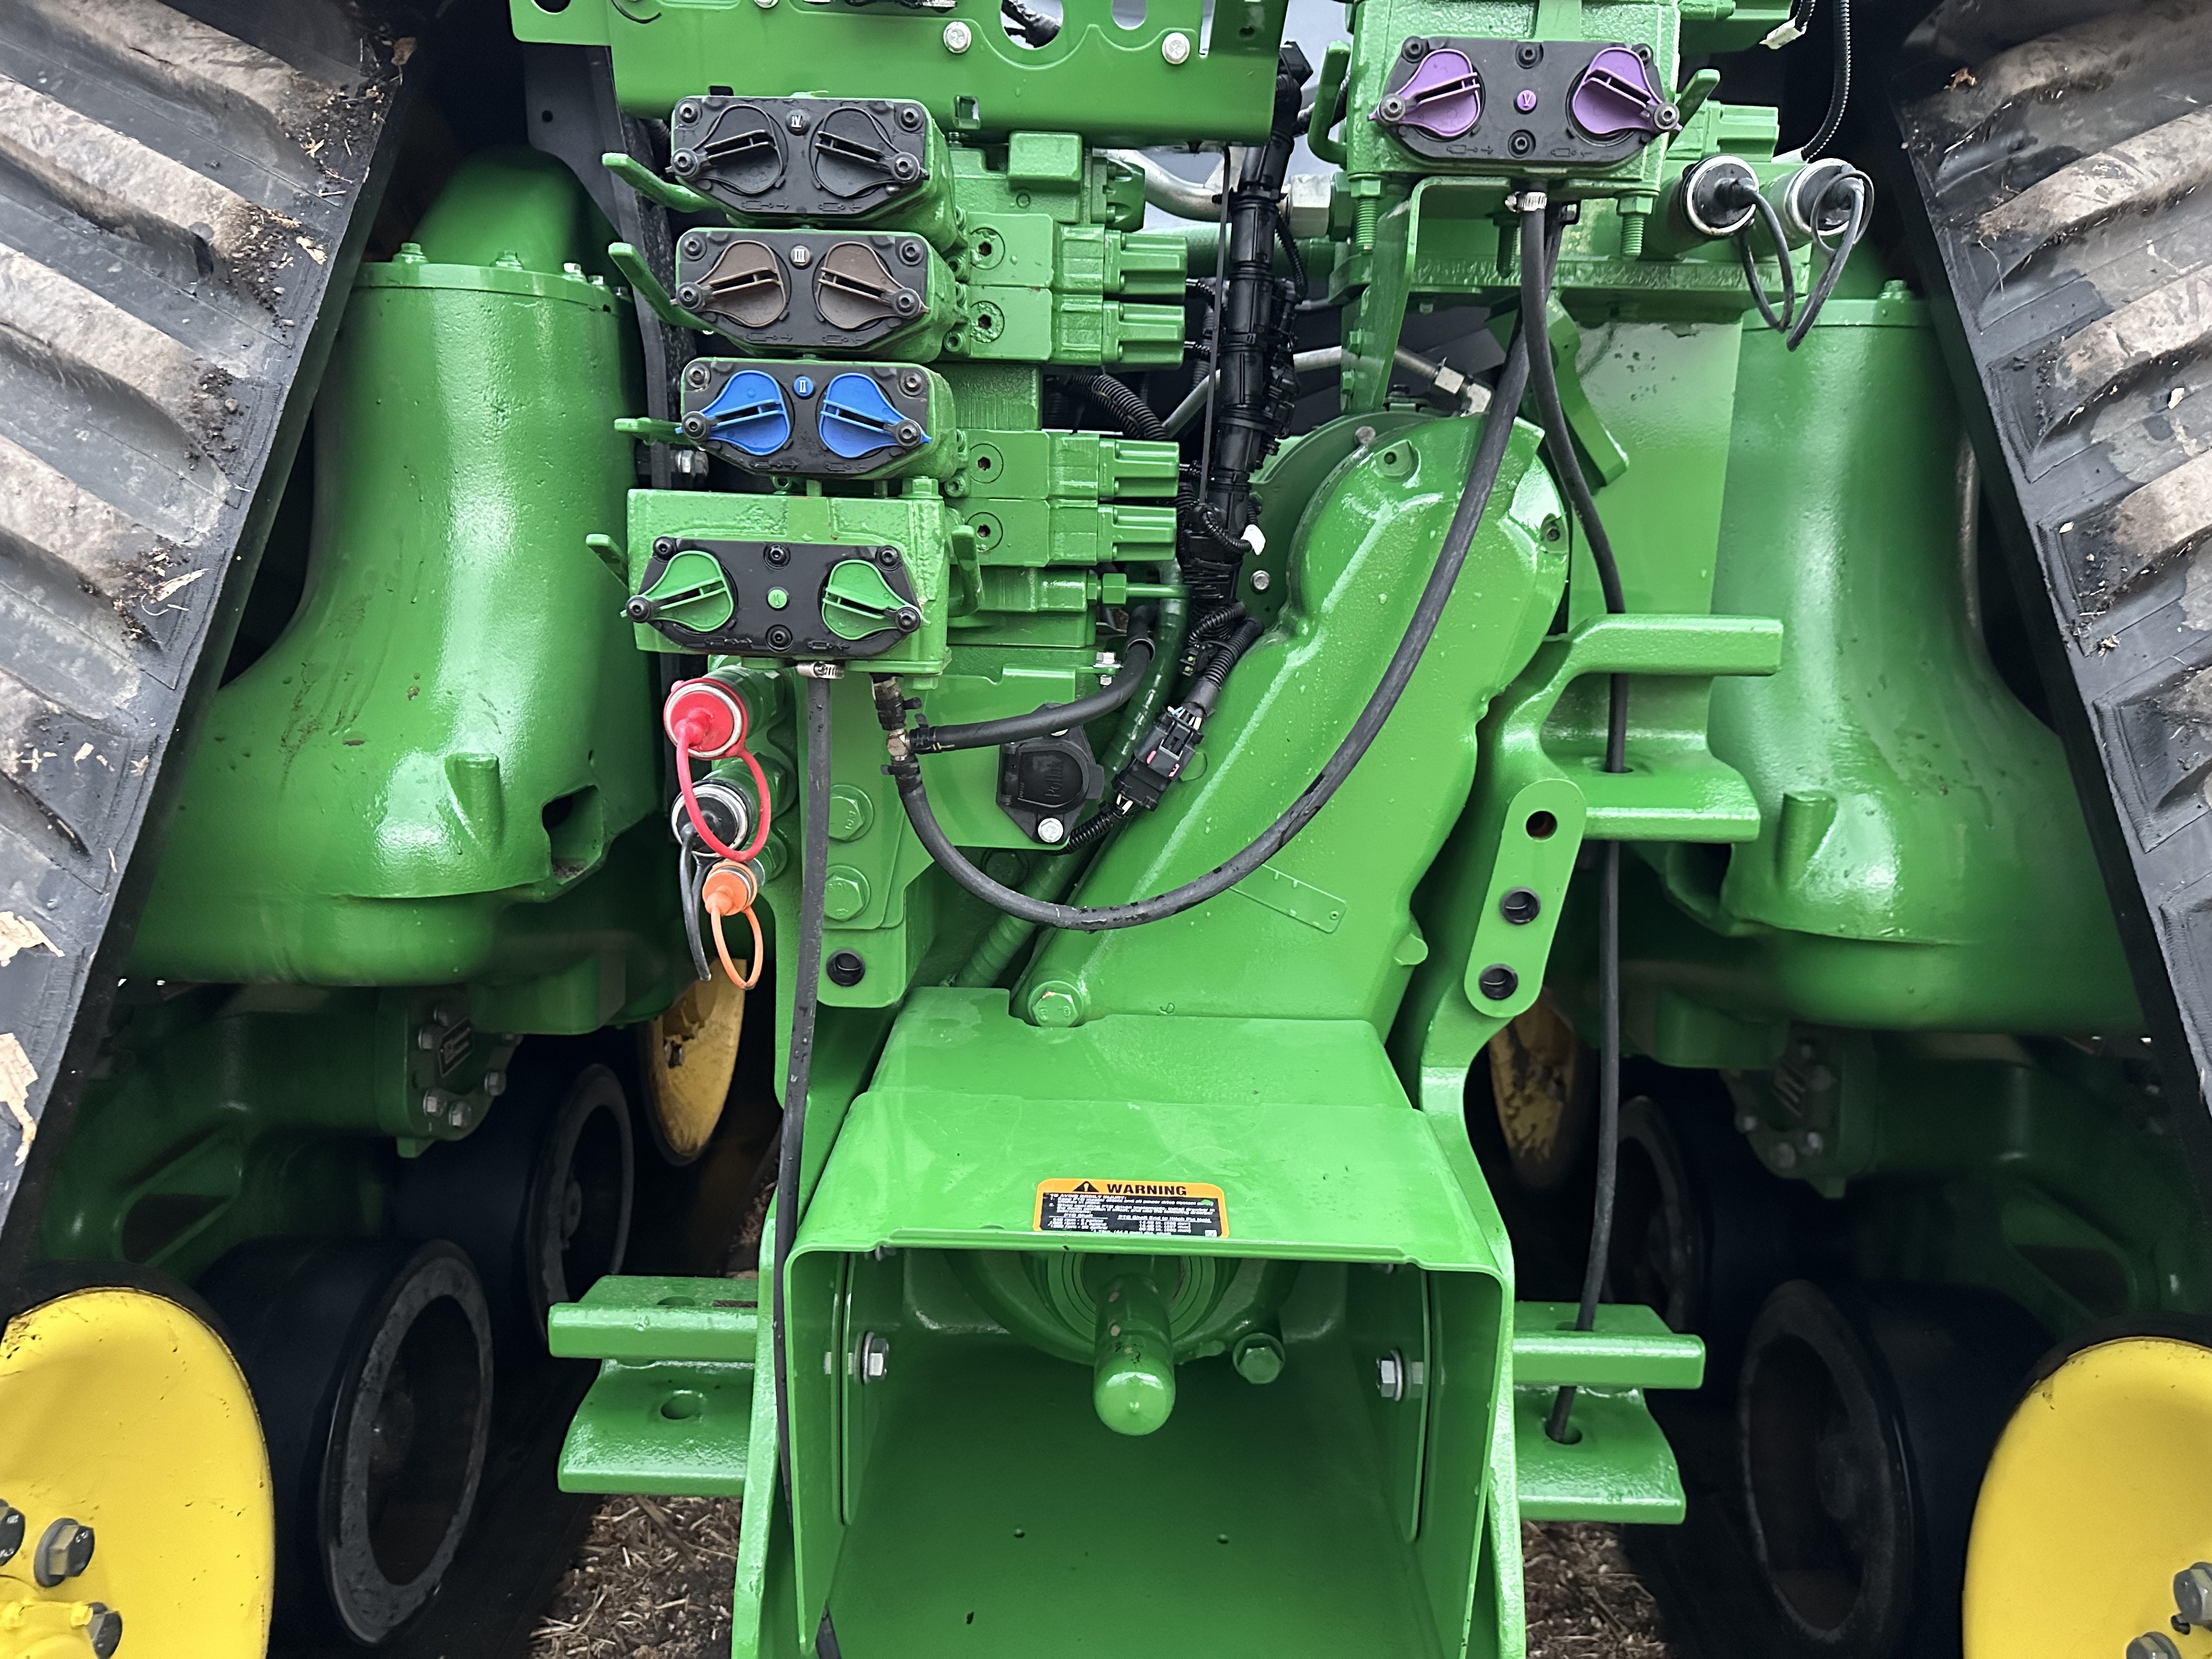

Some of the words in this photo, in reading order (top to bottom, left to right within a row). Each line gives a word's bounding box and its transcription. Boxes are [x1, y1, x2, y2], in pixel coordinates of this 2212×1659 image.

[1523, 93, 1532, 106] V
[791, 115, 802, 128] IV
[793, 248, 806, 262] III
[799, 379, 807, 393] II
[1107, 1183, 1187, 1196] WARNING
